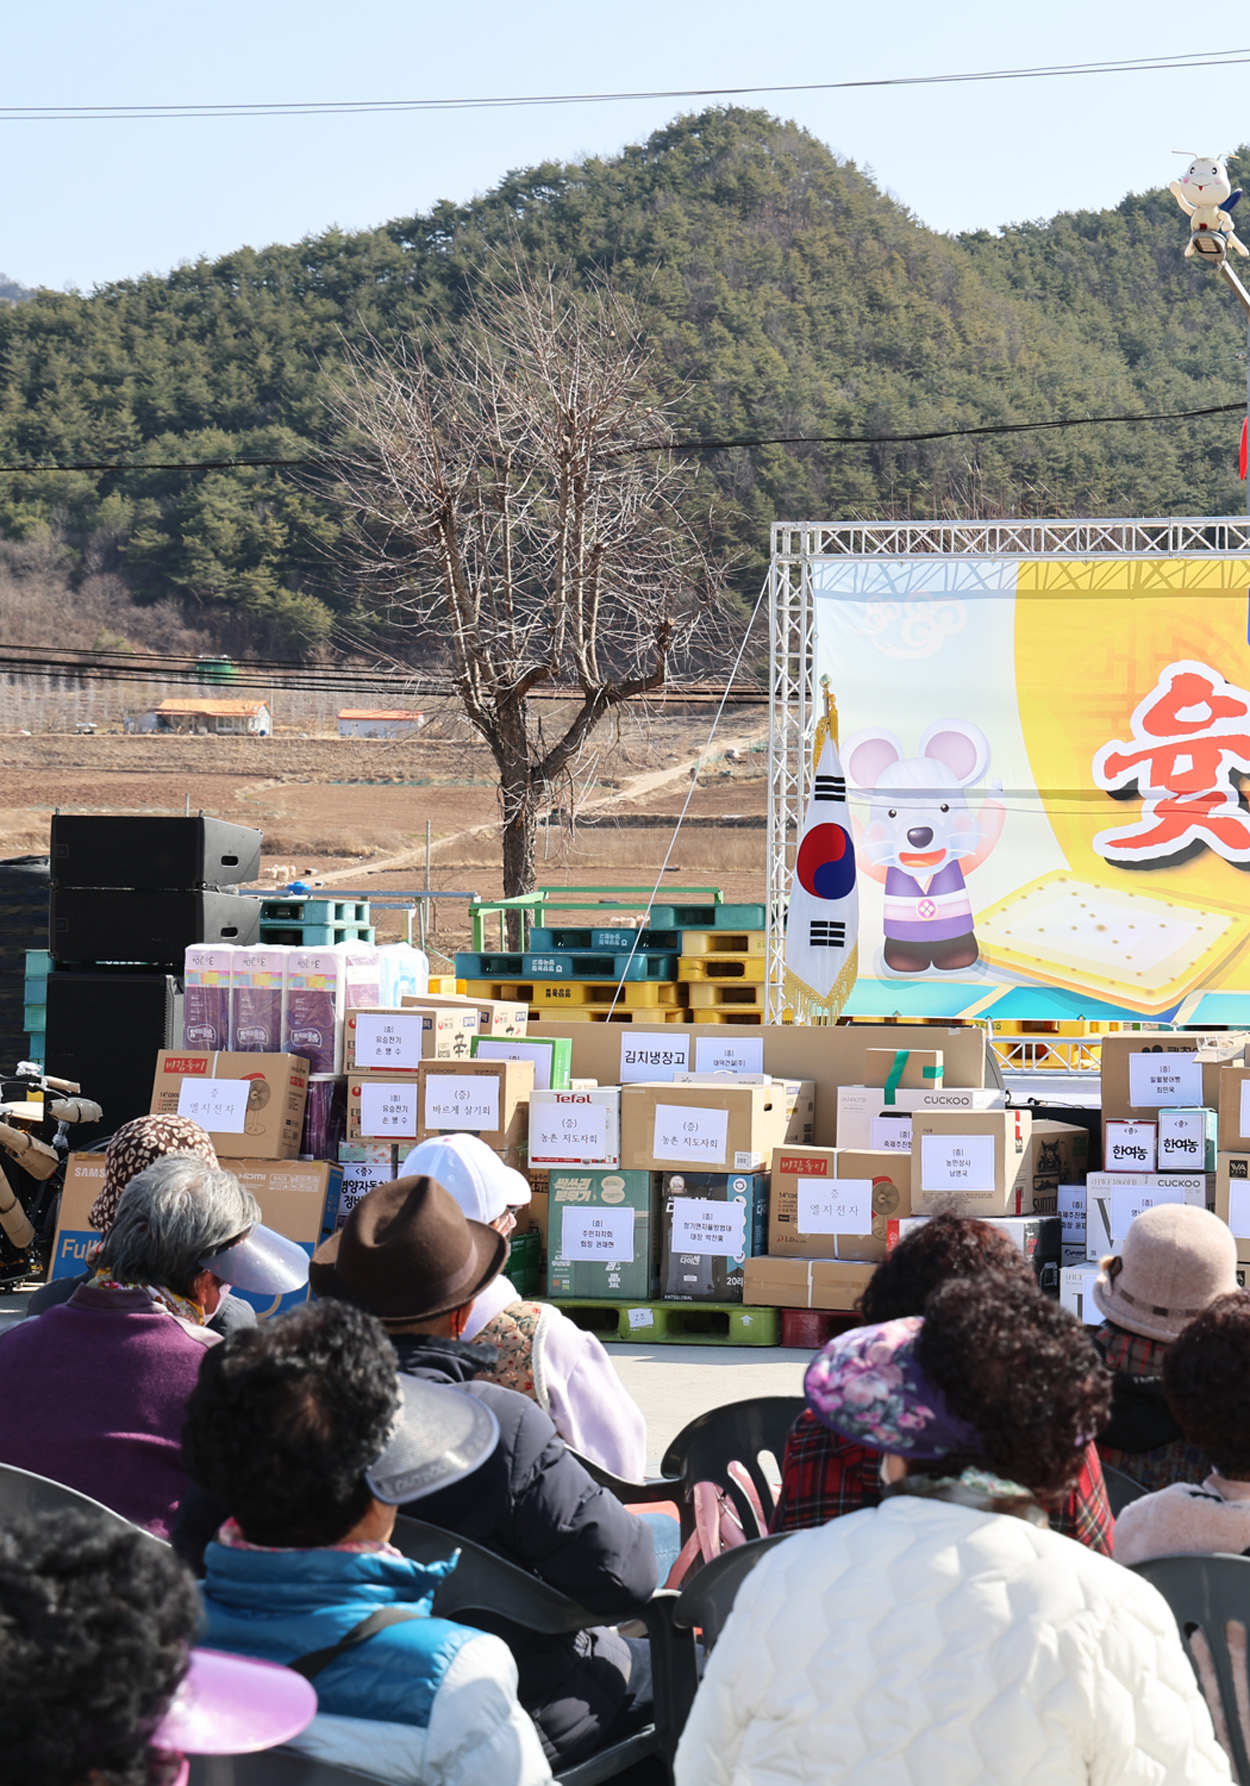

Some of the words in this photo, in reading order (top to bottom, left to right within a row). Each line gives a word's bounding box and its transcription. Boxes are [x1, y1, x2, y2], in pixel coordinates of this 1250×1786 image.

[625, 1050, 685, 1065] 김치냉장고
[553, 1094, 592, 1104] Tefal
[924, 1096, 970, 1105] CUCKOO
[190, 1103, 235, 1115] 엘지전자
[433, 1105, 459, 1115] 바르게
[465, 1105, 490, 1116] 살기회
[562, 1119, 577, 1129] (증)
[683, 1122, 699, 1132] (증)
[540, 1133, 558, 1143] 농촌
[562, 1134, 597, 1144] 지도자회
[662, 1136, 679, 1146] 농촌
[683, 1137, 718, 1149] 지도자회
[1163, 1138, 1199, 1153] 한여농
[1113, 1144, 1148, 1160] 한여농
[238, 1173, 266, 1181] HDMI
[1158, 1179, 1201, 1188] CUCKOO
[810, 1204, 859, 1216] 엘지전자
[62, 1238, 95, 1259] Ful
